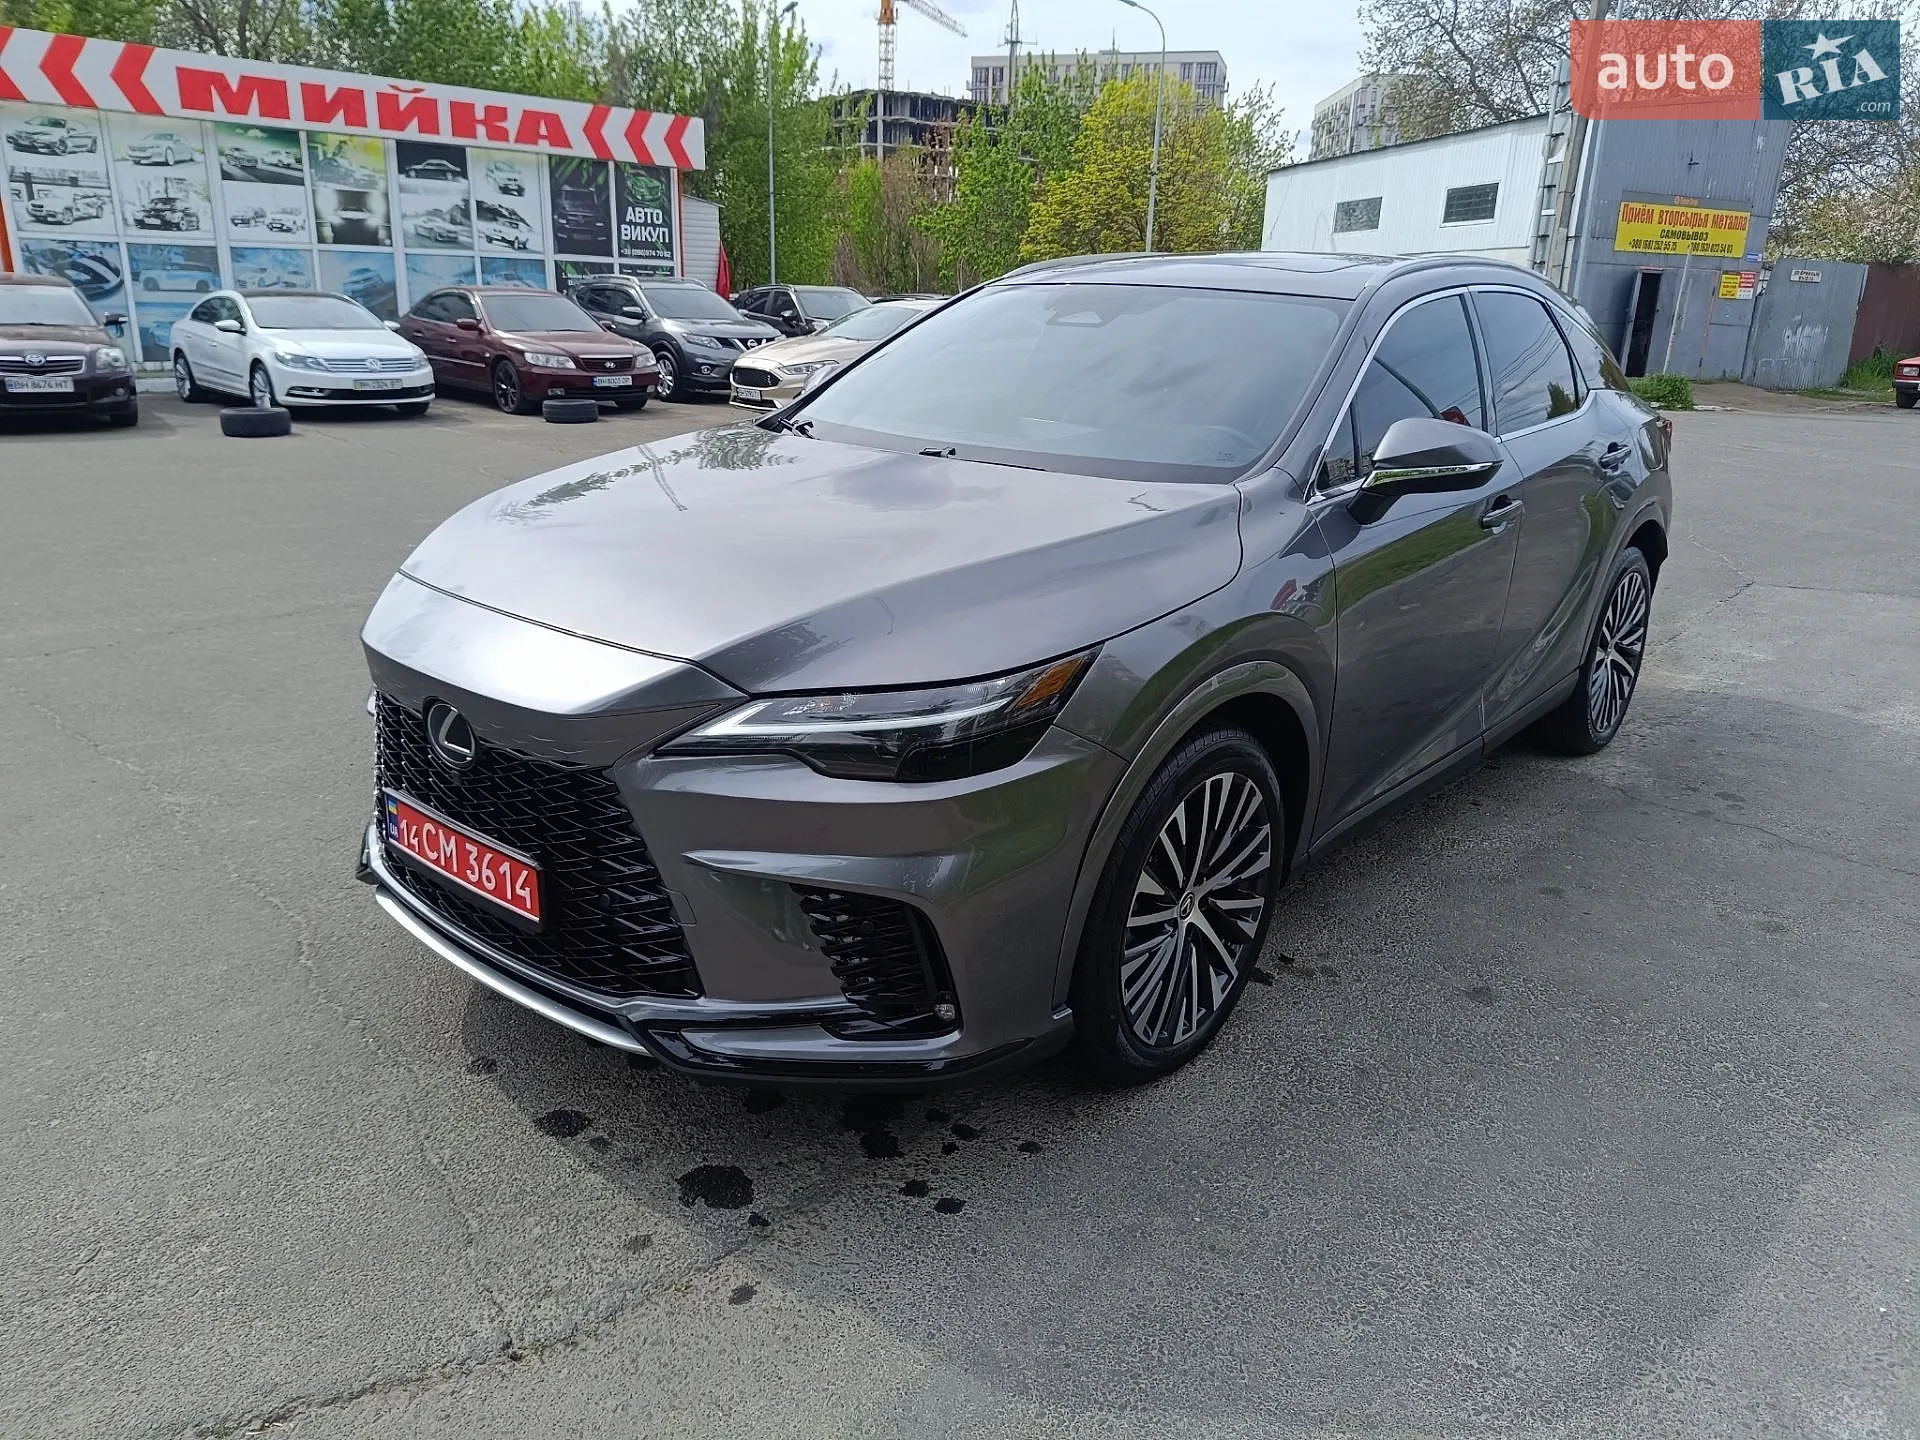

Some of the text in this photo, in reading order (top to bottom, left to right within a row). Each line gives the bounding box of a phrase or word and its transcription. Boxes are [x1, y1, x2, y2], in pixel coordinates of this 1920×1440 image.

[175, 66, 573, 150] МИЙКА
[625, 206, 663, 225] АВТО
[1621, 203, 1748, 231] Приём вторсырья металла
[620, 224, 669, 243] ВИКУП
[1659, 228, 1709, 242] САМОВЫВОЗ
[465, 842, 532, 909] 3614
